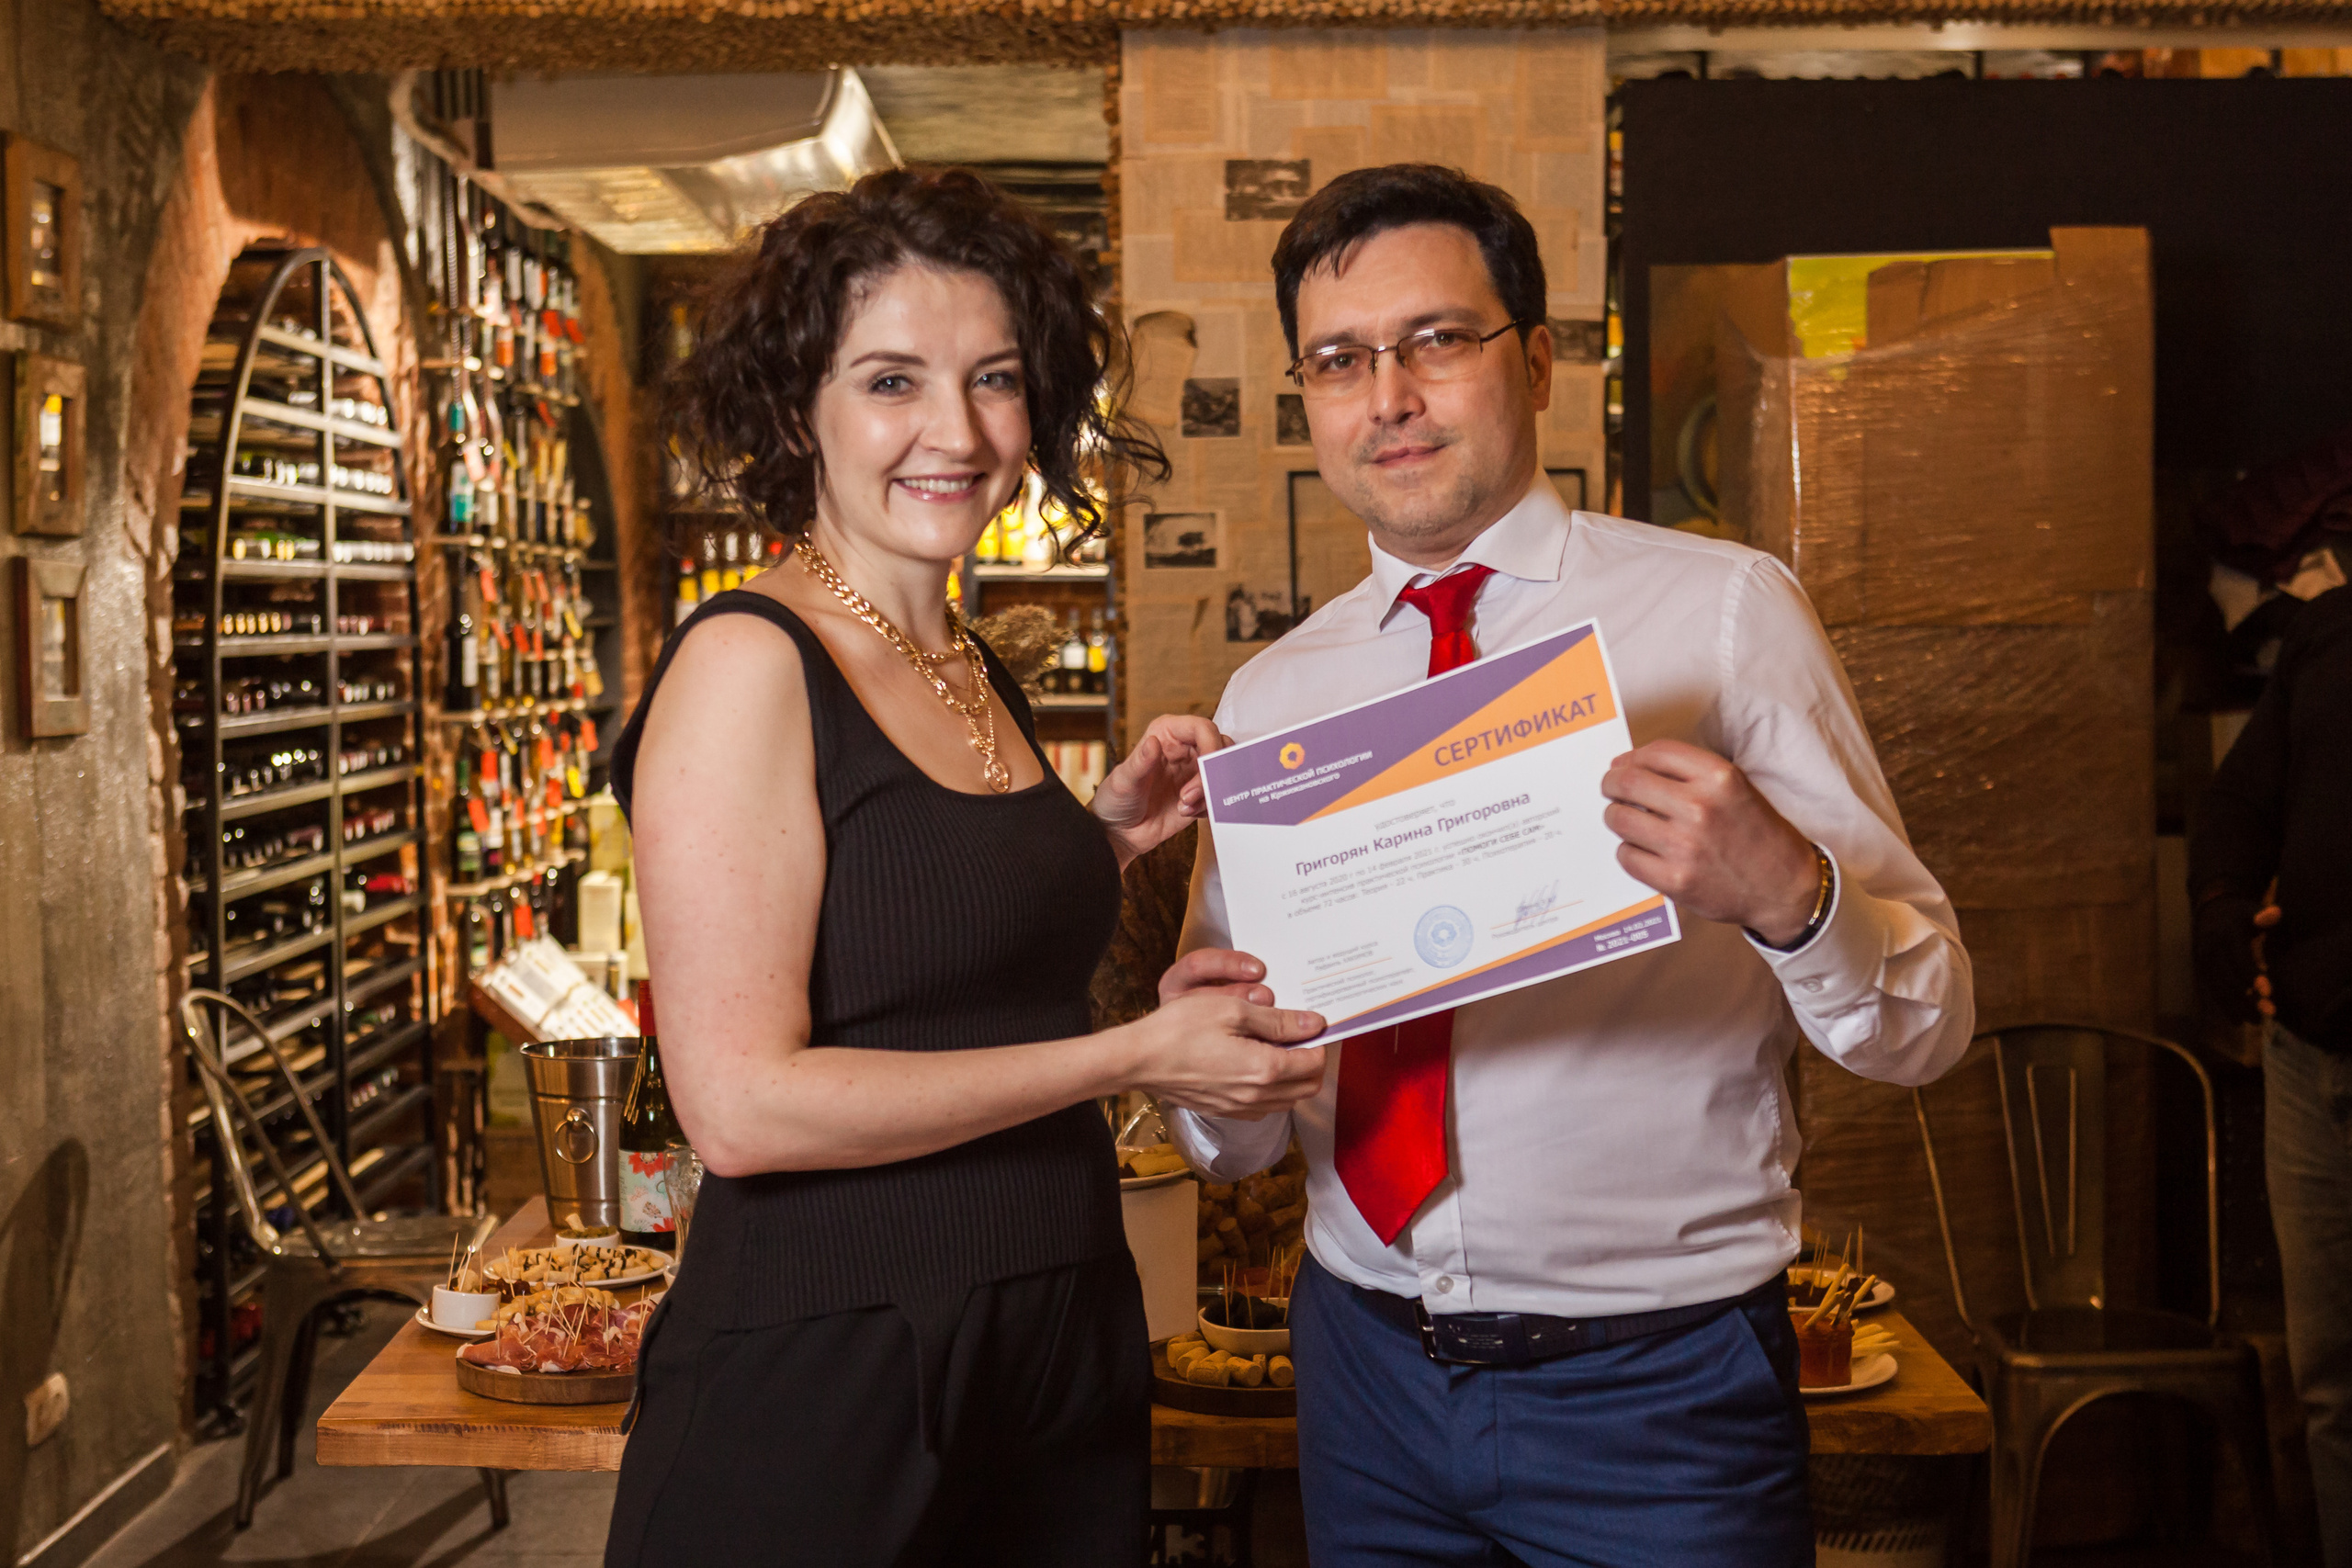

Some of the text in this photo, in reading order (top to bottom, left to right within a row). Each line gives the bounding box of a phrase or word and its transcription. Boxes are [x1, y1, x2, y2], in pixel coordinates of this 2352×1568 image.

[1316, 750, 1373, 775] ПСИХОЛОГИИ
[1432, 694, 1600, 767] СЕРТИФИКАТ
[1295, 793, 1531, 876] Григорян Карина Григоровна
